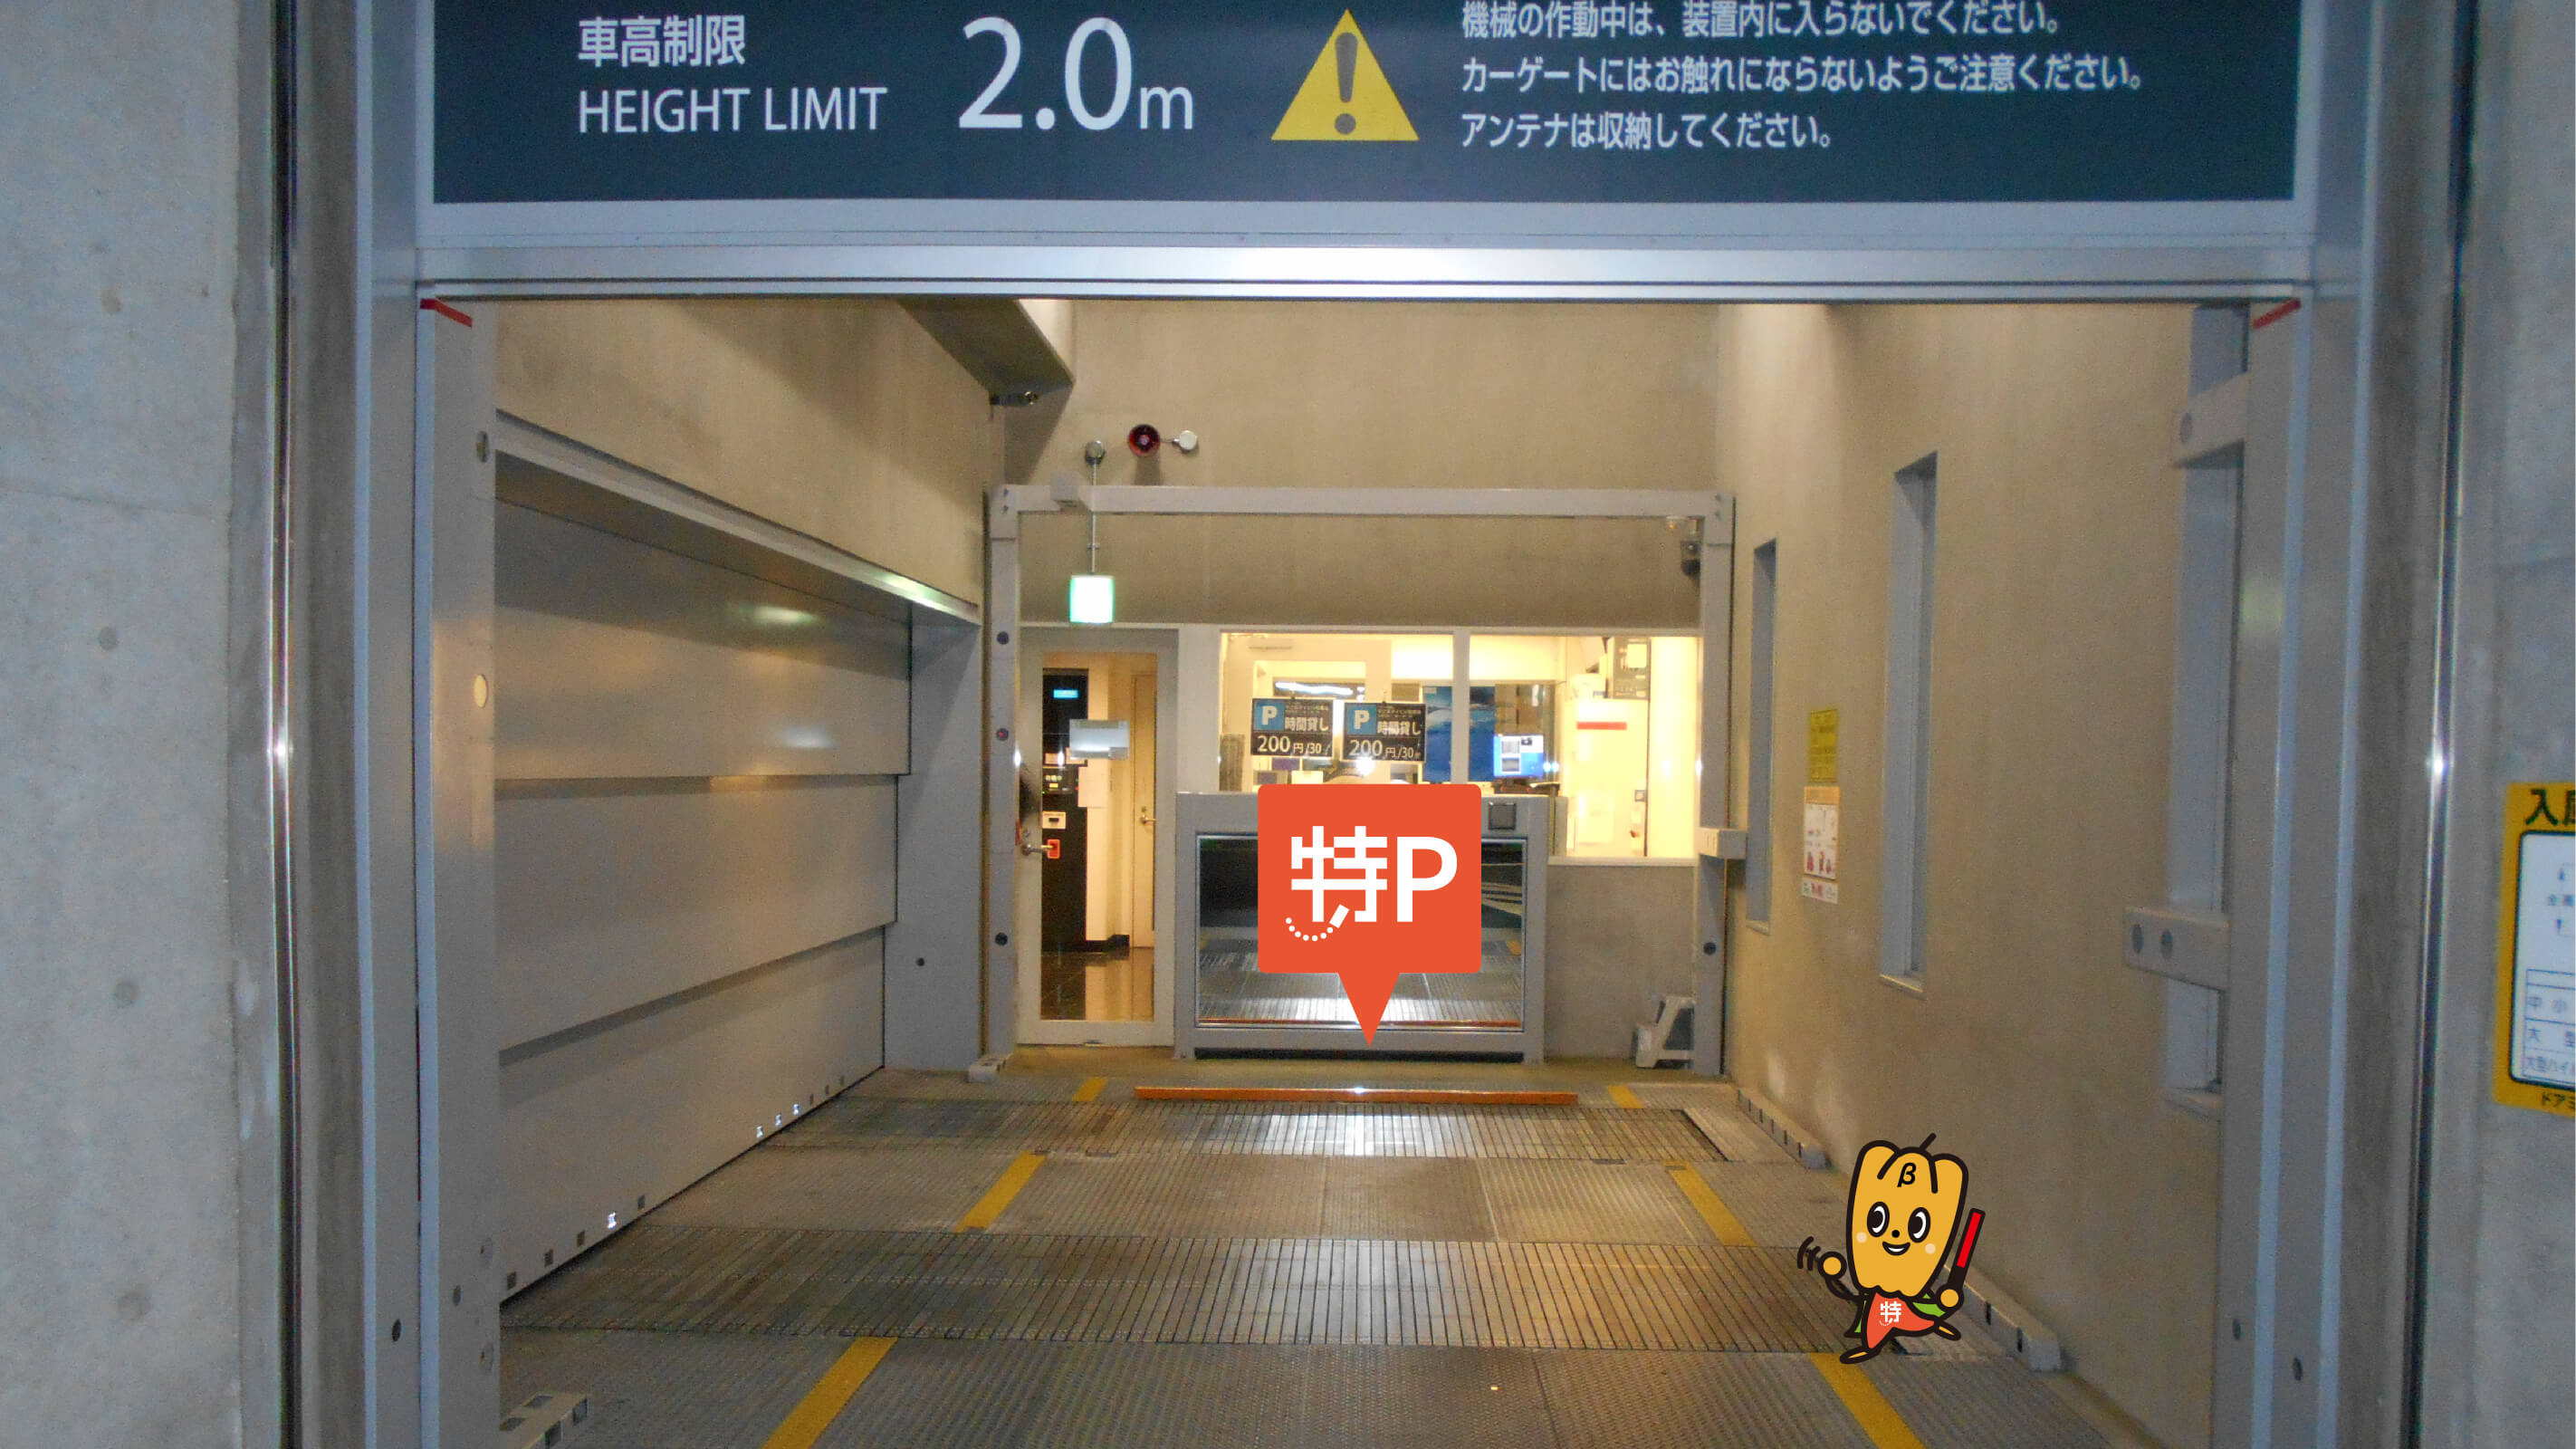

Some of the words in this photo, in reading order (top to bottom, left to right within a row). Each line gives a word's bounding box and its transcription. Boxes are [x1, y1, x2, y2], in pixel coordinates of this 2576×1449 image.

[1462, 0, 2058, 38] 機械の作動中は、装置内に入らないでください。
[578, 14, 746, 67] 車高制限
[1461, 53, 2141, 93] カーゲートにはお触れにならないようご注意ください。
[579, 88, 750, 133] HEIGHT
[764, 87, 887, 131] LIMIT
[1461, 111, 1831, 150] アンテナは収納してください。
[1262, 705, 1278, 725] P
[1354, 709, 1370, 730] P
